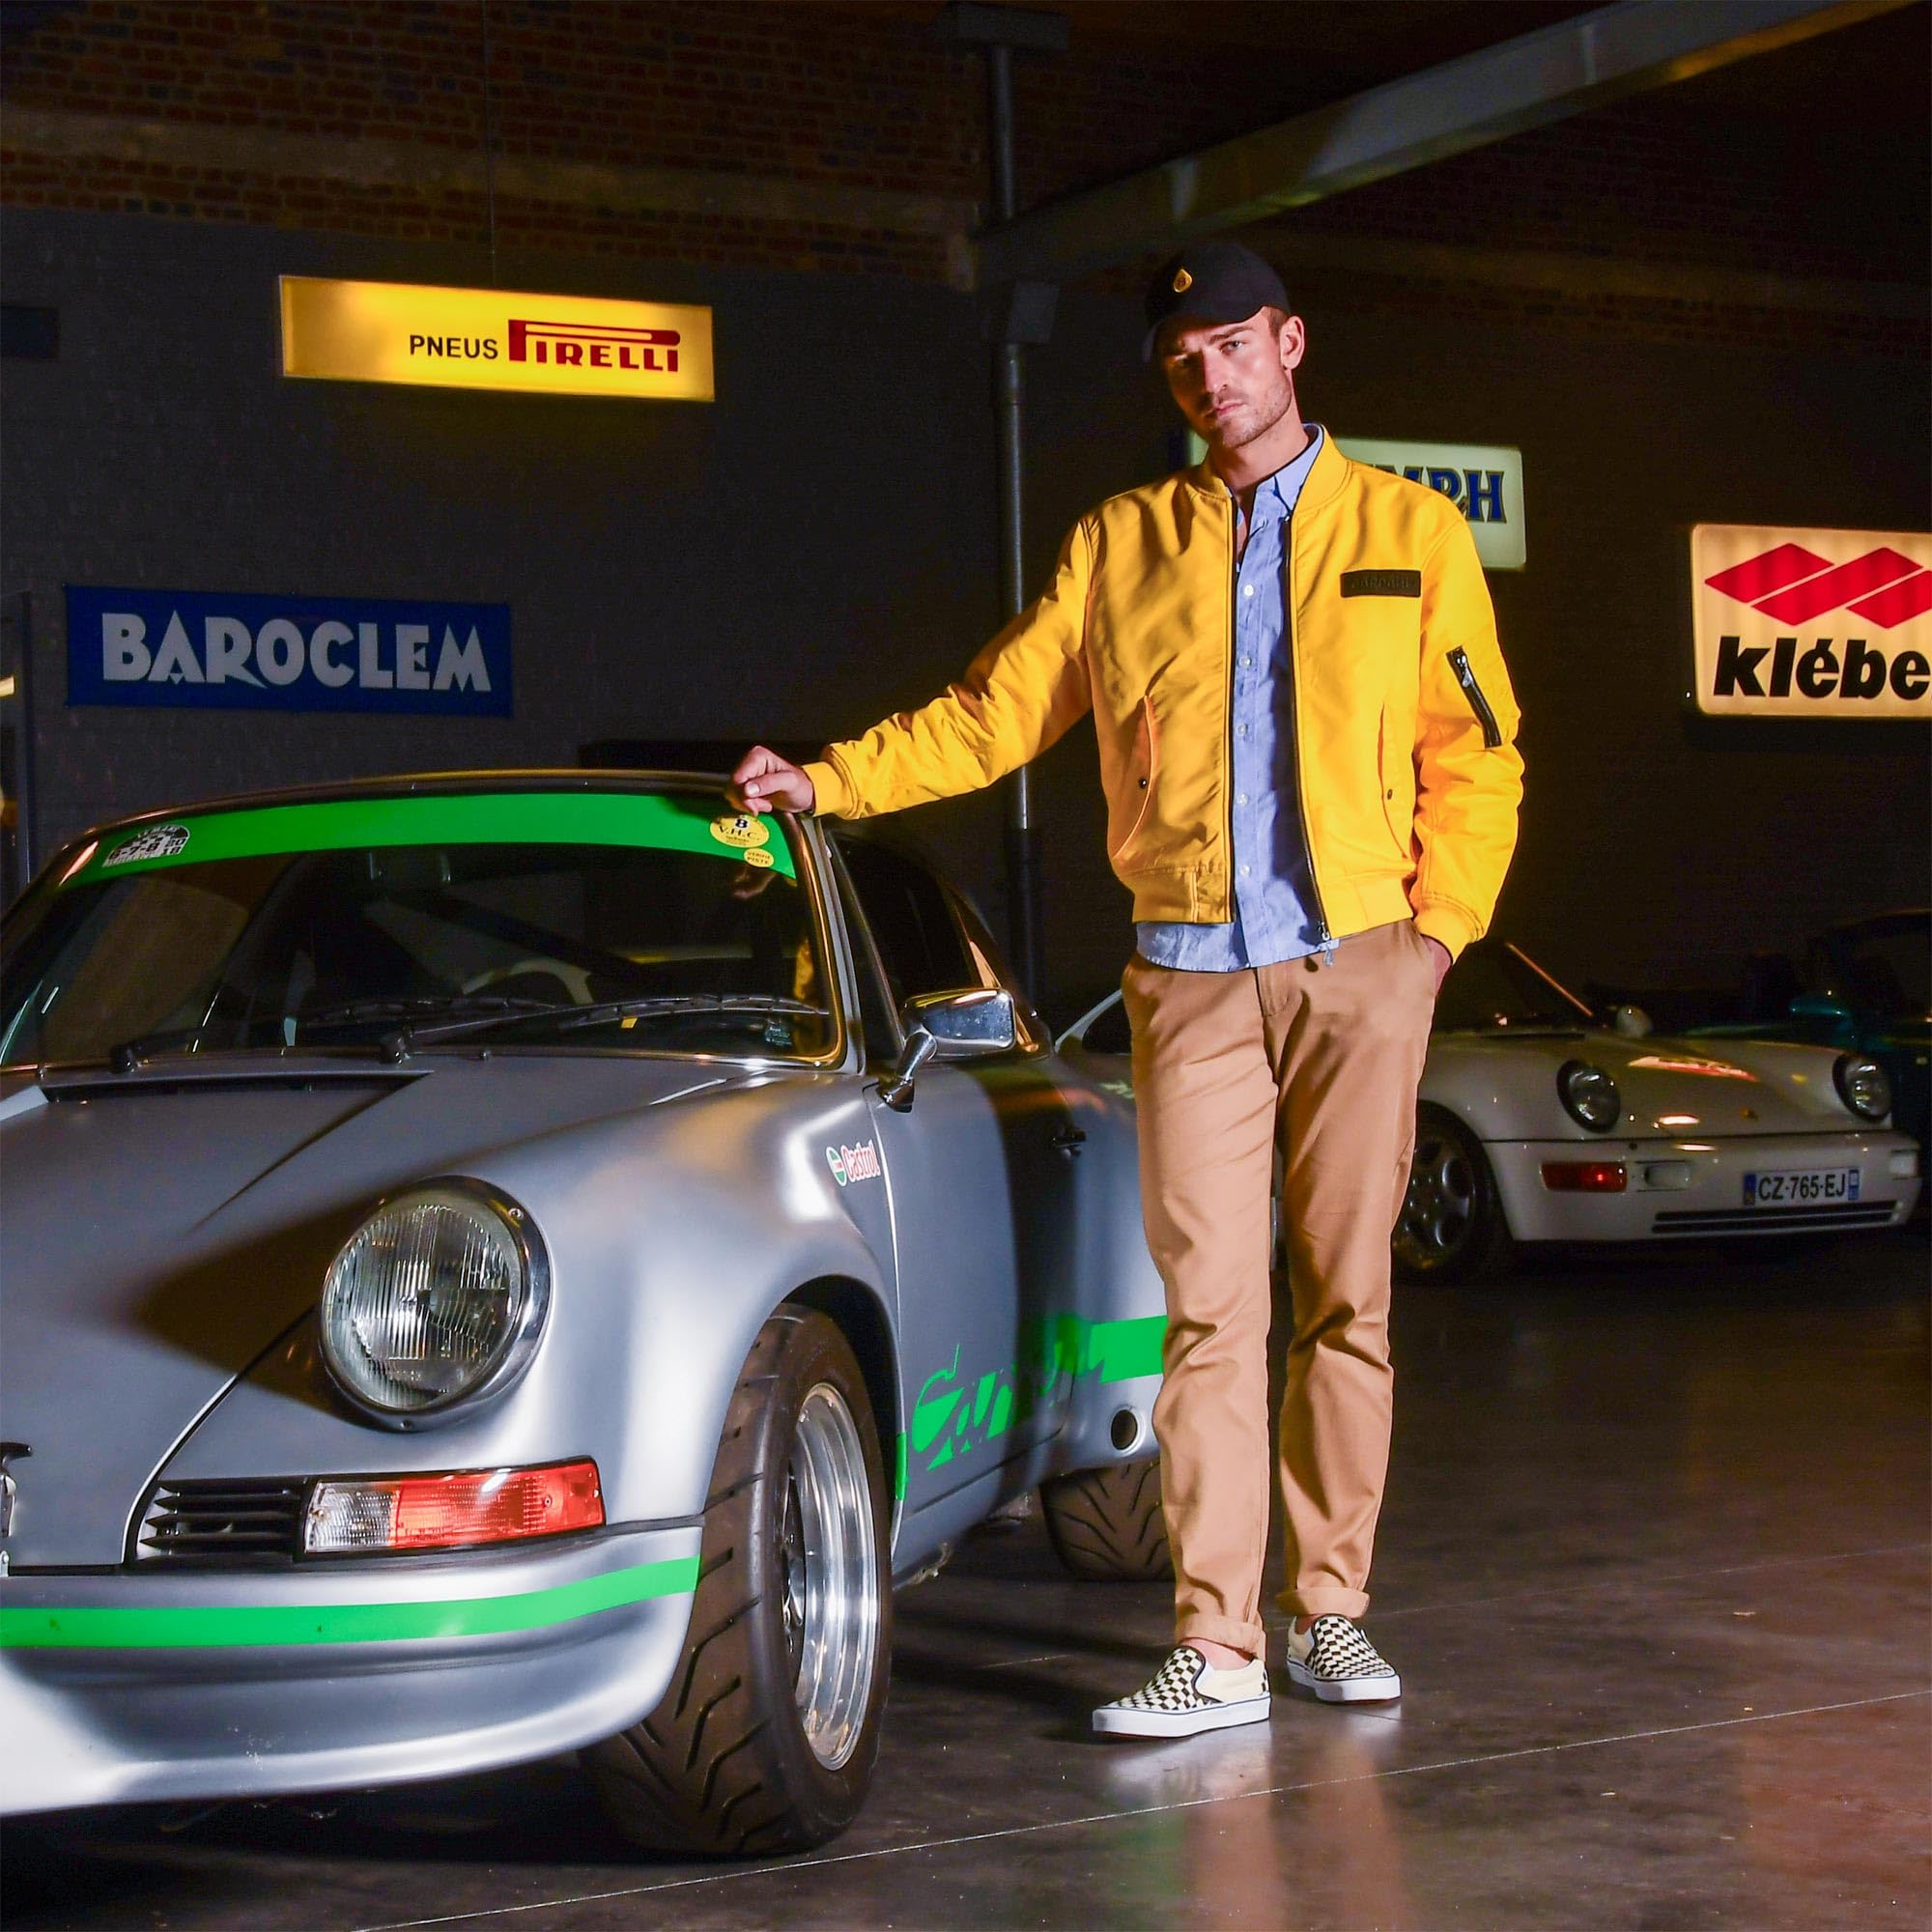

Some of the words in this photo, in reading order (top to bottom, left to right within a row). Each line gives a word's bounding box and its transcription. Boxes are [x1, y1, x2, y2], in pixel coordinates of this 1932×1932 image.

[409, 334, 498, 359] PNEUS
[508, 319, 681, 372] PIRELLI
[102, 610, 492, 693] BAROCLEM
[1713, 636, 1932, 700] klébe
[734, 818, 748, 829] 8
[840, 1139, 880, 1181] Castrol
